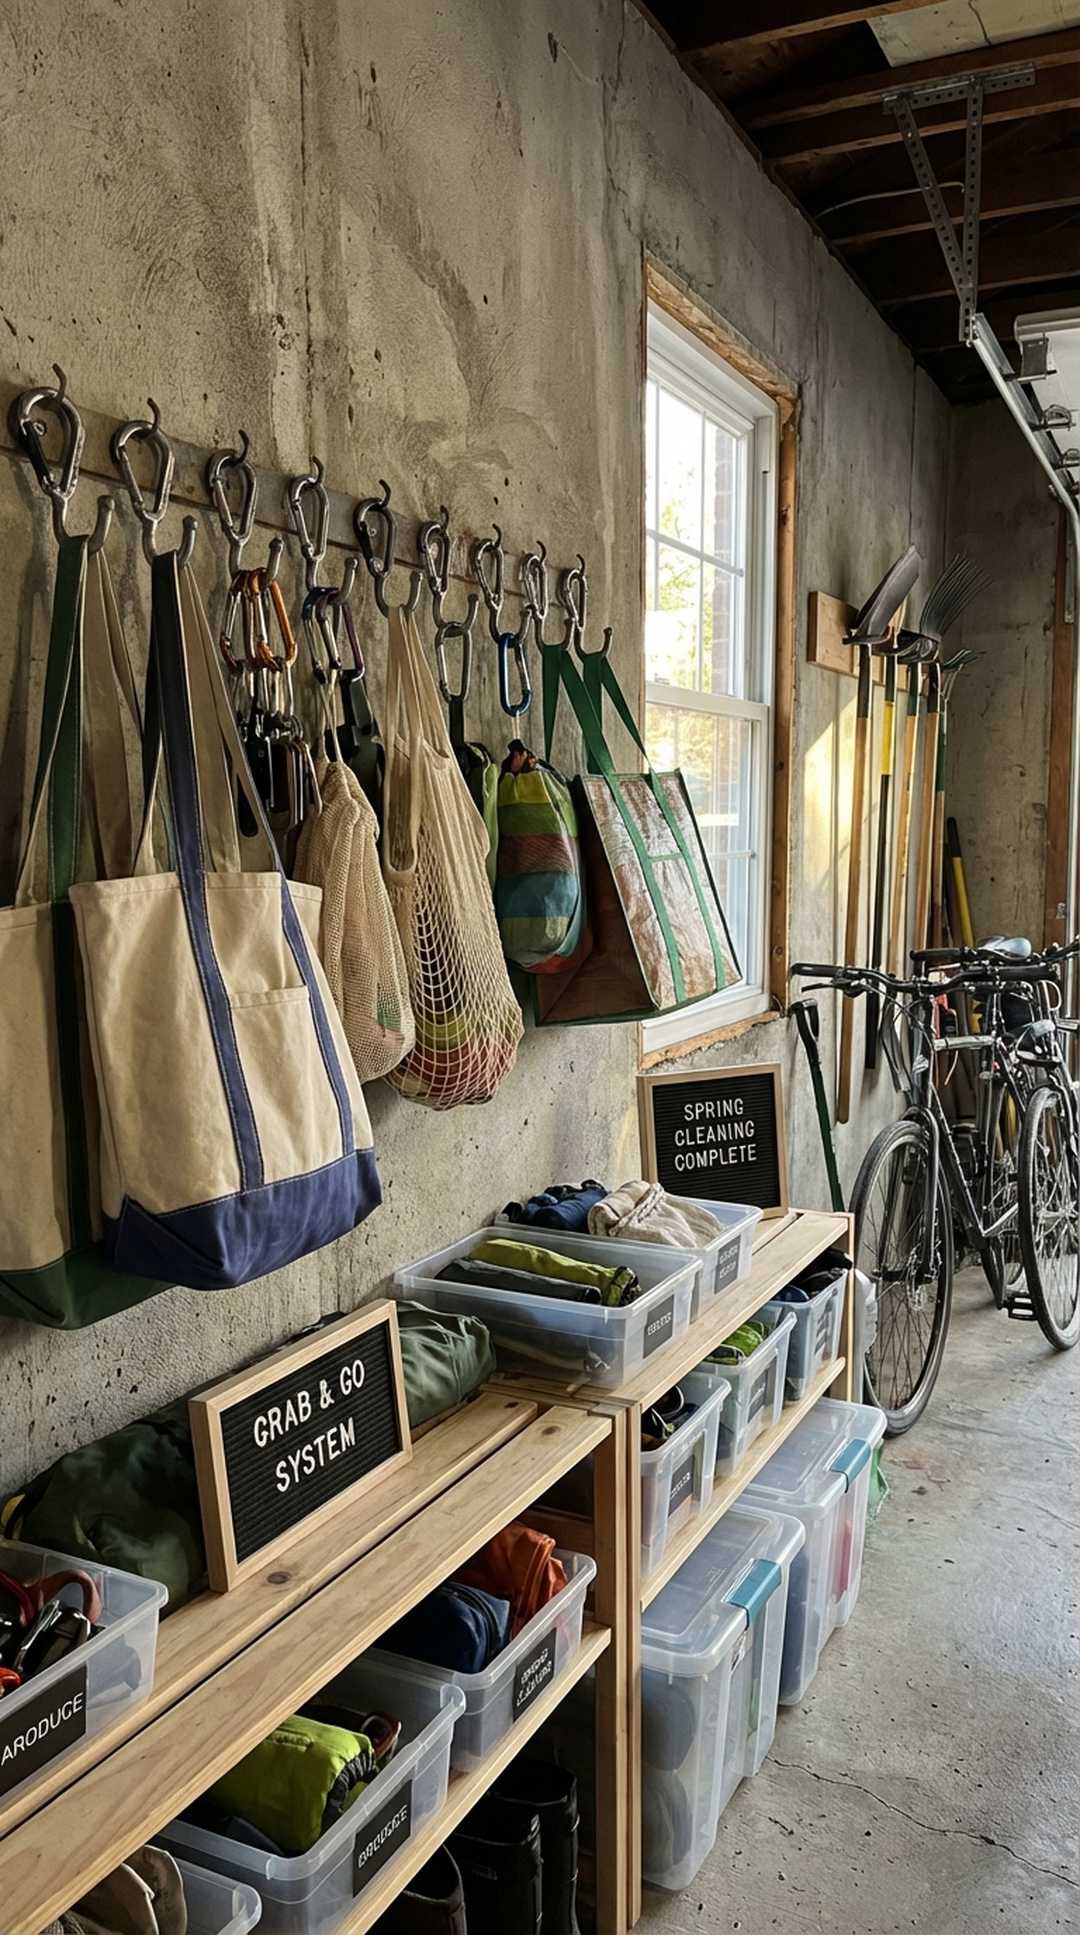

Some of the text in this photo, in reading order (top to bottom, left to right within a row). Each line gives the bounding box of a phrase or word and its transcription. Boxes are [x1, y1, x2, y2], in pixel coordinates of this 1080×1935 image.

[684, 1098, 744, 1121] SPRING
[674, 1120, 755, 1147] CLEANING
[674, 1144, 757, 1172] COMPLETE
[253, 1359, 365, 1448] GRAB & GO
[275, 1417, 356, 1493] SYSTEM
